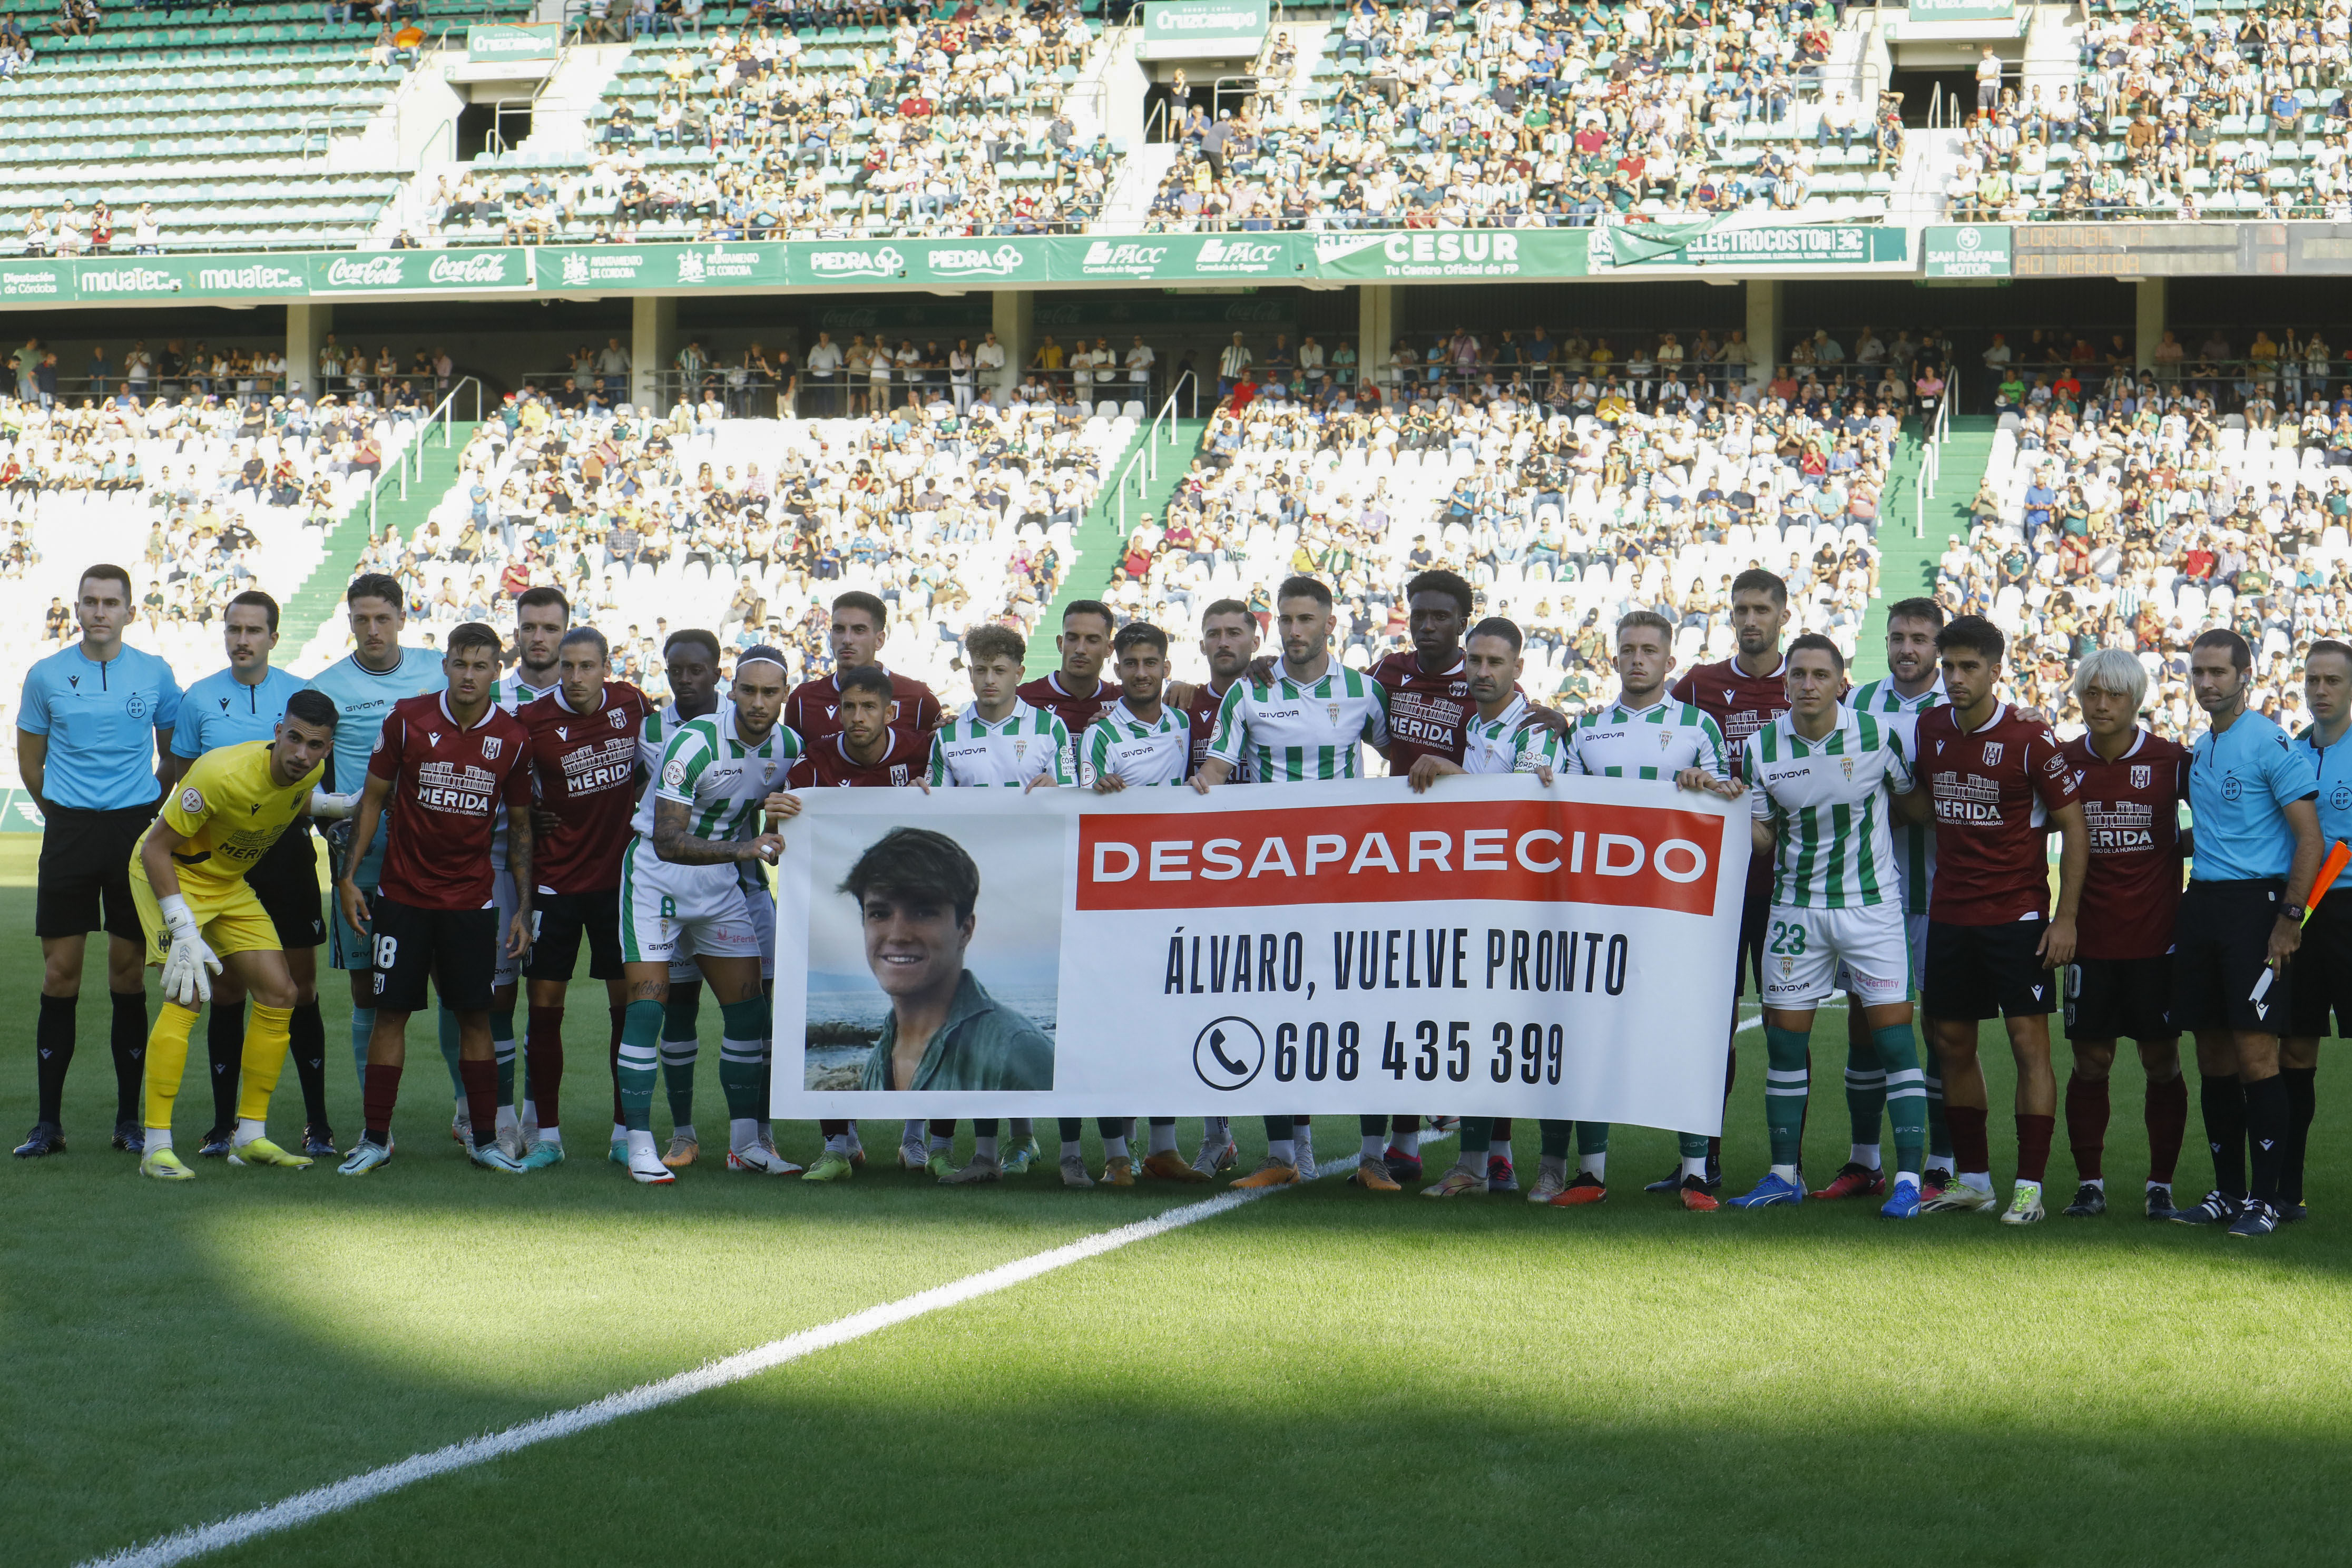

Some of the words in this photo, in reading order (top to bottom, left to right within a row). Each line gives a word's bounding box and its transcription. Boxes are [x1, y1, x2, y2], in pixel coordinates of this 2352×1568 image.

[1157, 10, 1257, 30] Cruzcampo
[473, 35, 553, 52] Cruzcampo
[445, 66, 455, 79] 2
[2016, 226, 2112, 247] CORDOBA
[2127, 226, 2154, 246] CF
[1109, 247, 1168, 264] PACC
[1222, 245, 1282, 262] PACC
[1384, 233, 1518, 262] CESUR
[1927, 251, 1956, 263] SAN
[1958, 250, 2008, 263] RAFAEL
[428, 253, 507, 283] Coca-Cola
[810, 251, 874, 270] PIEDRA
[928, 250, 993, 268] PIEDRA
[2016, 254, 2044, 275] AD
[2056, 253, 2140, 275] MERIDA
[3, 271, 56, 283] Diputación
[328, 256, 405, 285] Coca-Cola
[1384, 264, 1399, 276] Tu
[1402, 264, 1443, 276] Centro
[1444, 263, 1483, 275] Oficial
[1485, 264, 1501, 275] de
[1502, 263, 1520, 275] FP
[1944, 263, 1991, 275] MOTOR
[4, 283, 17, 294] de
[18, 281, 57, 294] Córdoba
[1033, 305, 1083, 324] oca-Cola
[345, 699, 384, 712] GIVOVA
[1390, 715, 1453, 745] MÉRIDA
[1585, 732, 1624, 741] GIVOVA
[948, 747, 986, 758] GIVOVA
[1121, 747, 1154, 758] GIVOVA
[1423, 740, 1454, 752] HUMANIDAD
[566, 760, 632, 792] MÉRIDA
[1769, 769, 1810, 780] GIVOVA
[2049, 769, 2063, 780] Maven
[417, 786, 488, 811] MÉRIDA
[568, 786, 600, 798] PATRIMONIO
[1934, 799, 2001, 820] MÉRIDA
[2090, 829, 2152, 847] ÉRIDA
[1092, 829, 1708, 883] DESAPARECIDO
[2120, 844, 2154, 852] HUMANIDAD
[660, 896, 676, 917] 8
[1769, 920, 1806, 956] 23
[371, 933, 398, 969] 18
[1164, 927, 1316, 1001] ÁLVARO,
[1334, 929, 1468, 991] VUELVE
[1486, 929, 1629, 996] PRONTO
[1769, 983, 1810, 992] GIVOVA
[1275, 1022, 1360, 1083] 608
[1381, 1021, 1470, 1083] 435
[1490, 1022, 1564, 1086] 399
